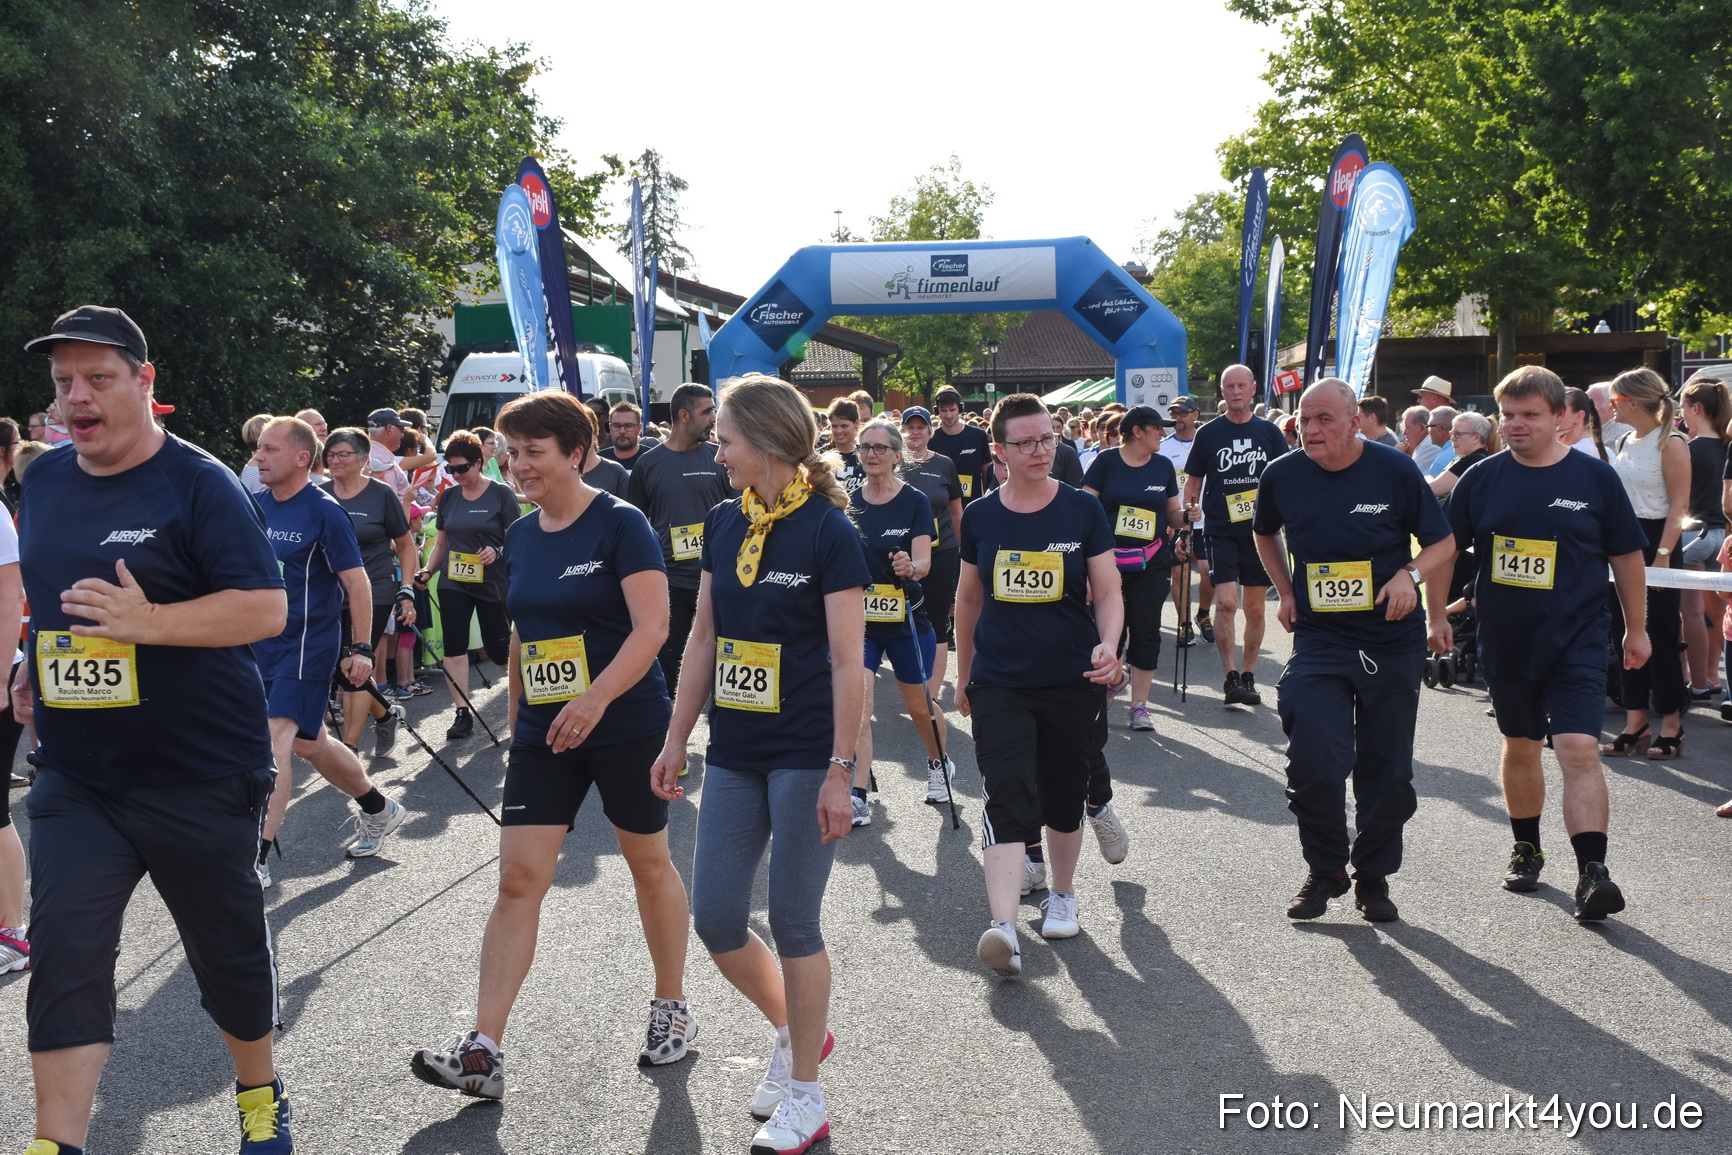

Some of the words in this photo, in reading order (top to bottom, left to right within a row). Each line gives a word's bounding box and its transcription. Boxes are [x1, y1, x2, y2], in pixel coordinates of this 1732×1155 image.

[917, 276, 1001, 293] firmenlauf
[759, 310, 804, 320] Fischer
[1216, 446, 1268, 476] Burgis
[1223, 476, 1260, 485] Knödellieb
[1350, 503, 1379, 514] JURA
[1548, 498, 1578, 508] JURA
[1121, 516, 1150, 531] 1451
[100, 529, 139, 546] JURA
[271, 529, 302, 543] POLES
[682, 534, 704, 549] 148
[1042, 542, 1072, 552] JURA
[454, 562, 475, 575] 175
[559, 563, 589, 579] JURA
[1499, 553, 1546, 575] 1418
[759, 570, 795, 584] JURA
[1002, 568, 1054, 589] 1430
[1314, 579, 1364, 598] 1392
[863, 596, 899, 612] 1462
[48, 659, 122, 687] 1435
[526, 660, 577, 687] 1409
[718, 662, 768, 693] 1428
[58, 687, 85, 695] Reulein
[87, 687, 112, 695] Marco
[723, 688, 741, 697] Nunner
[741, 691, 757, 699] Gabi
